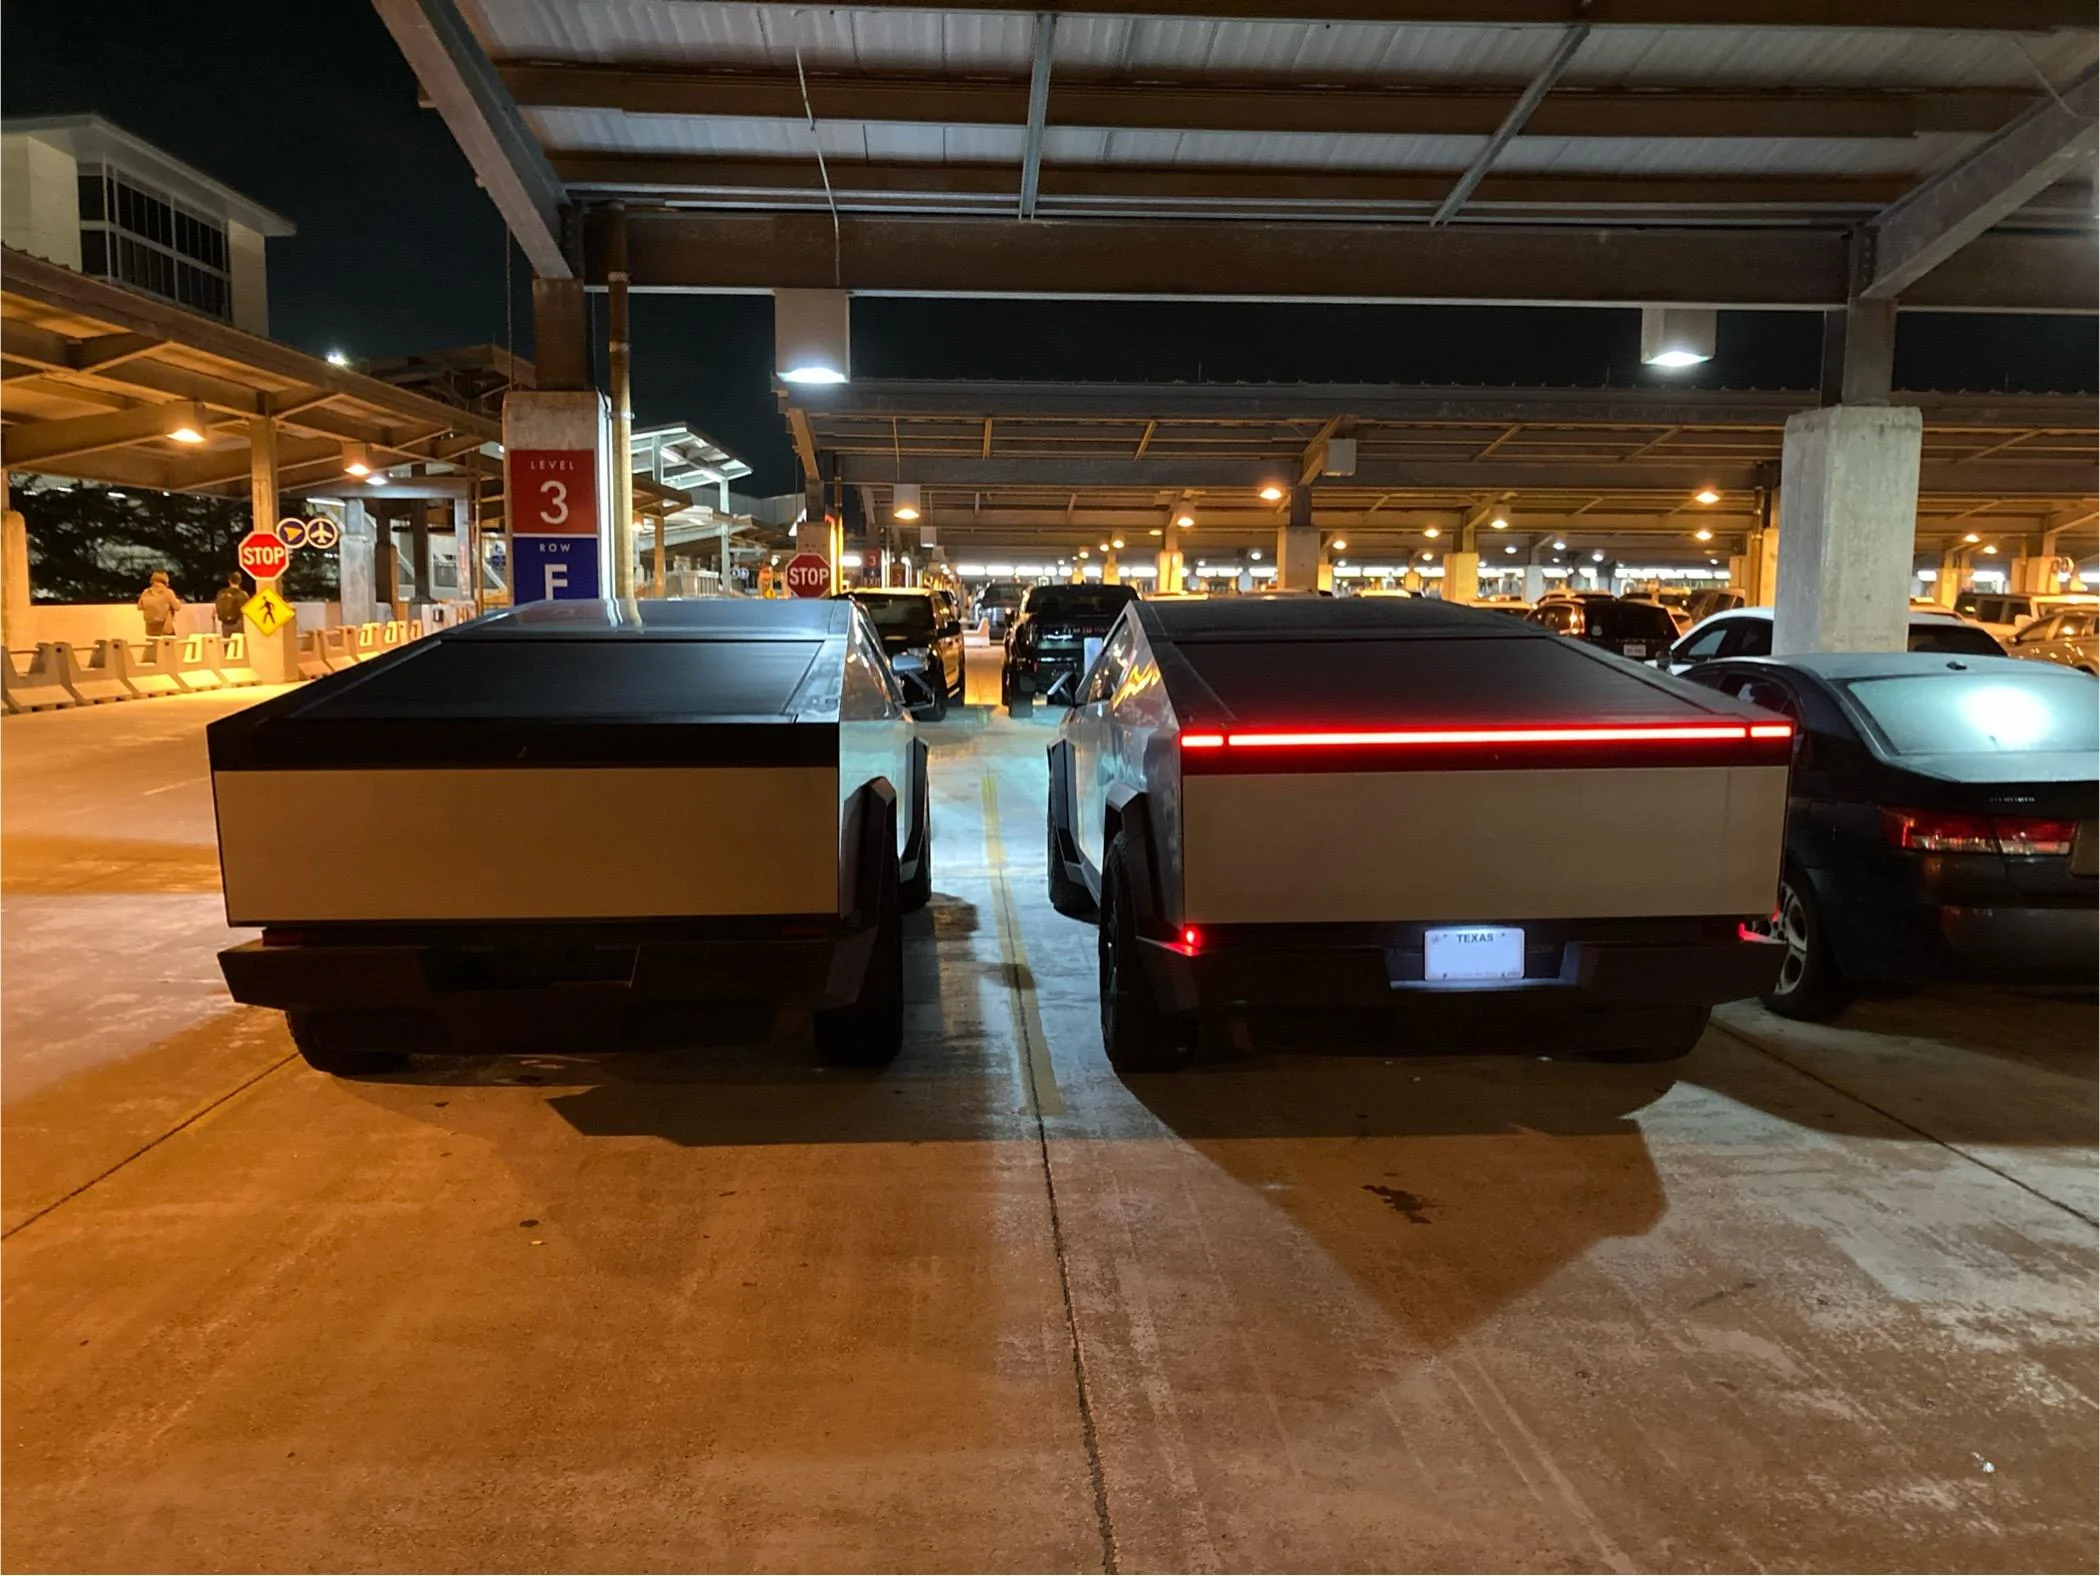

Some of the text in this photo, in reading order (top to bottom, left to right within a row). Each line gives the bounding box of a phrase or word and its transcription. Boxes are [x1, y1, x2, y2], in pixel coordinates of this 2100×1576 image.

[530, 460, 575, 470] LEVEL
[540, 480, 569, 525] 3
[243, 546, 285, 566] STOP
[539, 543, 571, 552] ROW
[544, 564, 568, 600] F
[789, 567, 830, 586] STOP
[1457, 933, 1494, 943] TEXAS
